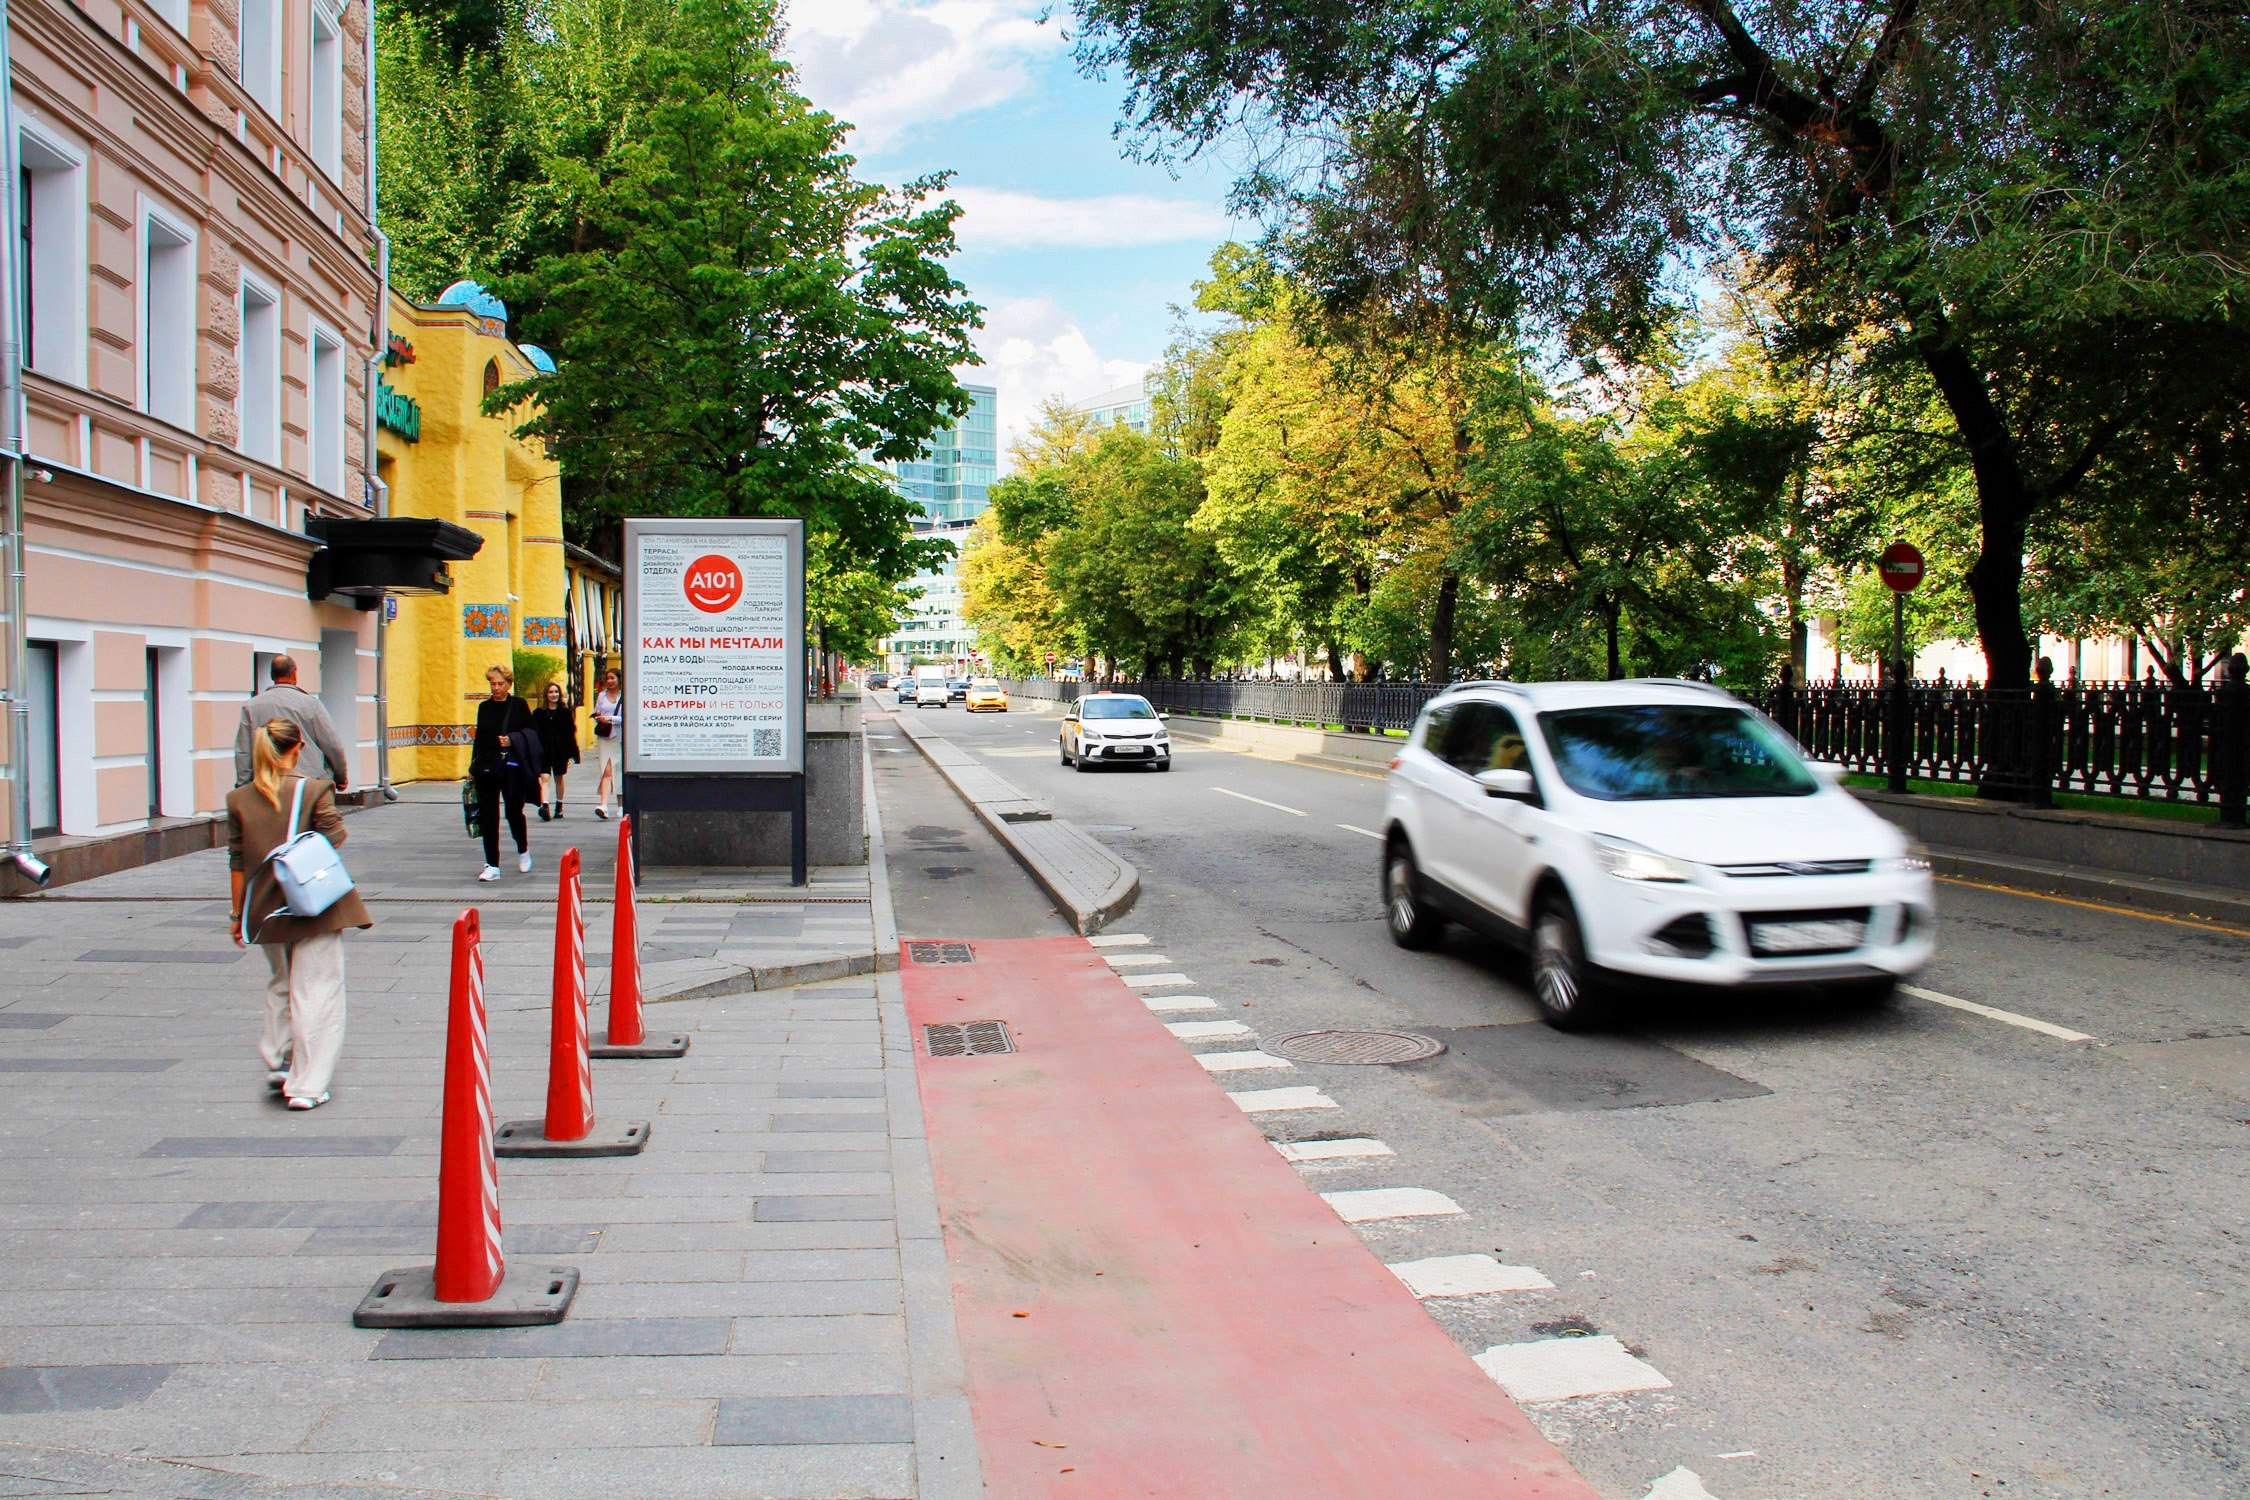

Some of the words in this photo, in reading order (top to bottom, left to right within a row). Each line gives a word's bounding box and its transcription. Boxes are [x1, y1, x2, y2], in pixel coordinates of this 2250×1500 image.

[643, 638, 674, 648] КАК
[680, 638, 705, 648] МЫ
[710, 638, 783, 648] МЕЧТАЛИ
[643, 656, 670, 664] ДОМА
[680, 656, 706, 664] ВОДЫ
[642, 686, 671, 695] РЯДОМ
[674, 685, 718, 694] МЕТРО
[643, 700, 706, 708] КВАРТИРЫ
[710, 700, 717, 708] И
[720, 700, 735, 708] НЕ
[738, 700, 784, 708] ТОЛЬКО
